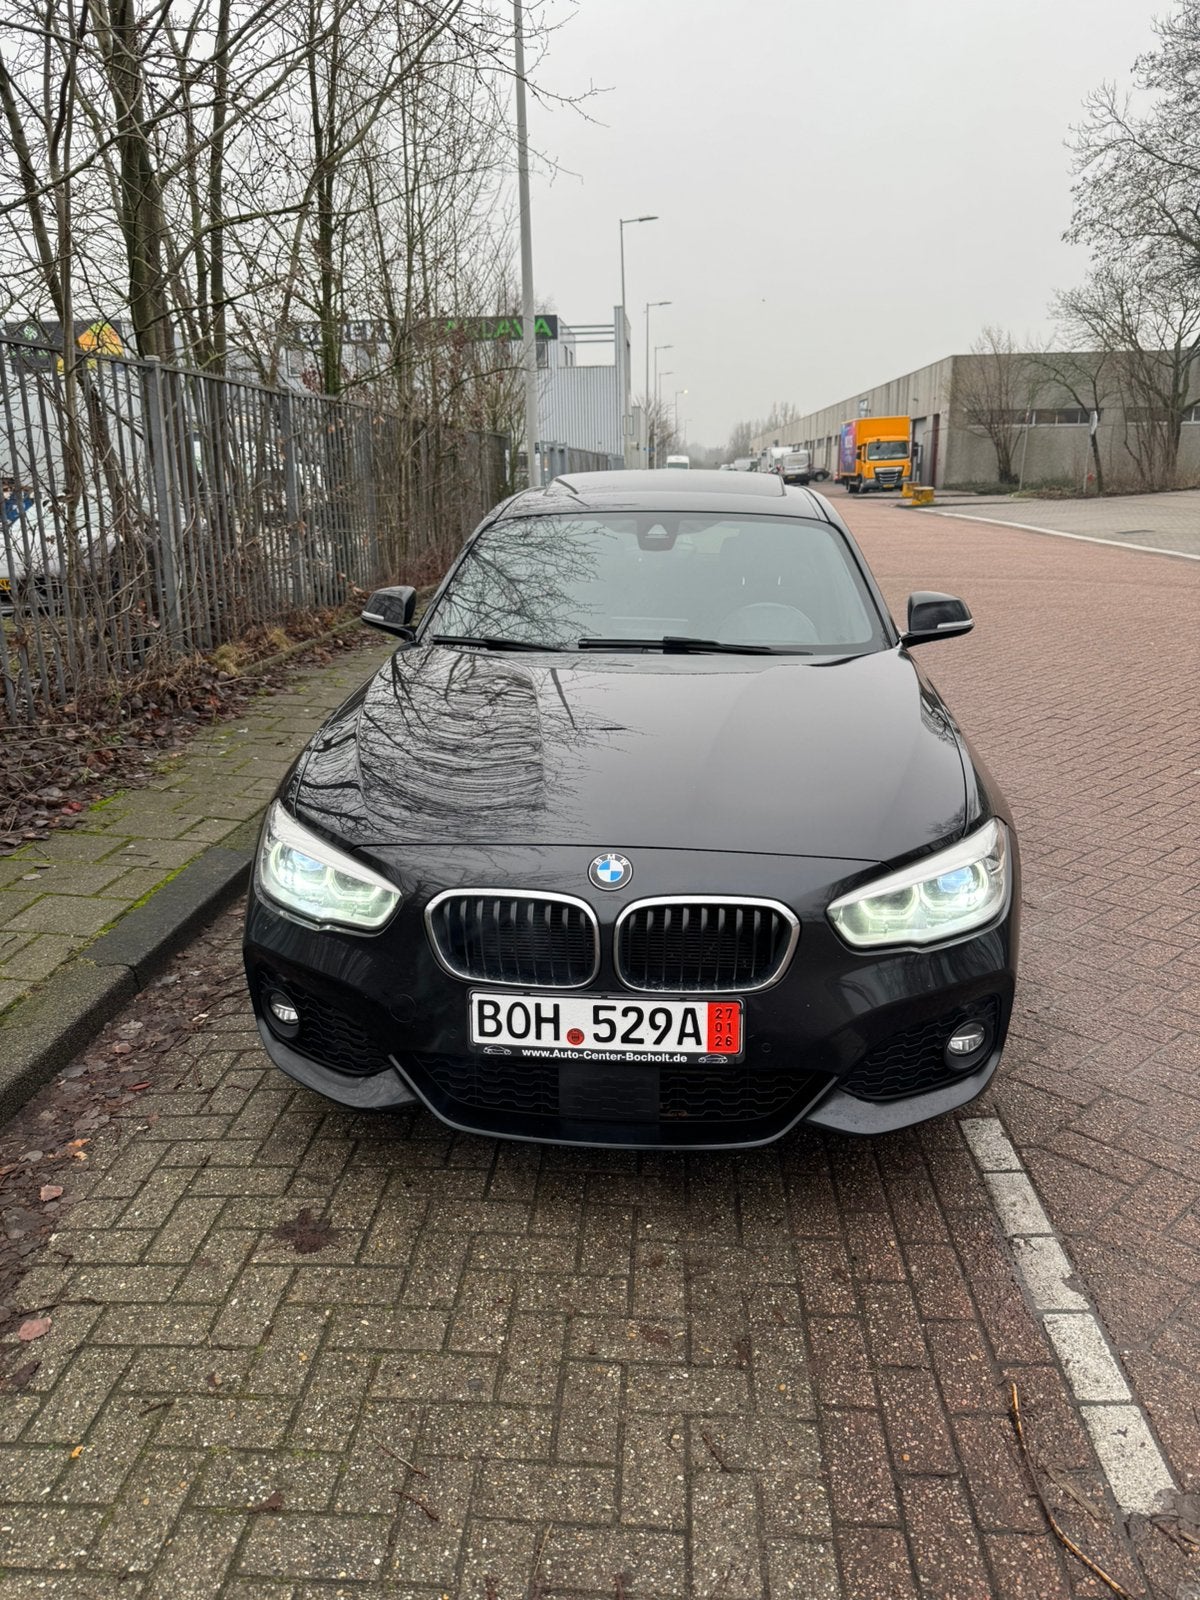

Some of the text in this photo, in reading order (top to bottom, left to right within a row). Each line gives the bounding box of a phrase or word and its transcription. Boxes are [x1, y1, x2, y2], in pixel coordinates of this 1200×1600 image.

[594, 853, 629, 866] BMW
[715, 1008, 733, 1019] 27
[477, 999, 702, 1046] BOH 529A
[715, 1022, 732, 1033] 01
[715, 1036, 733, 1047] 26
[521, 1048, 688, 1063] www.Auto-Center-Bocholt.de
